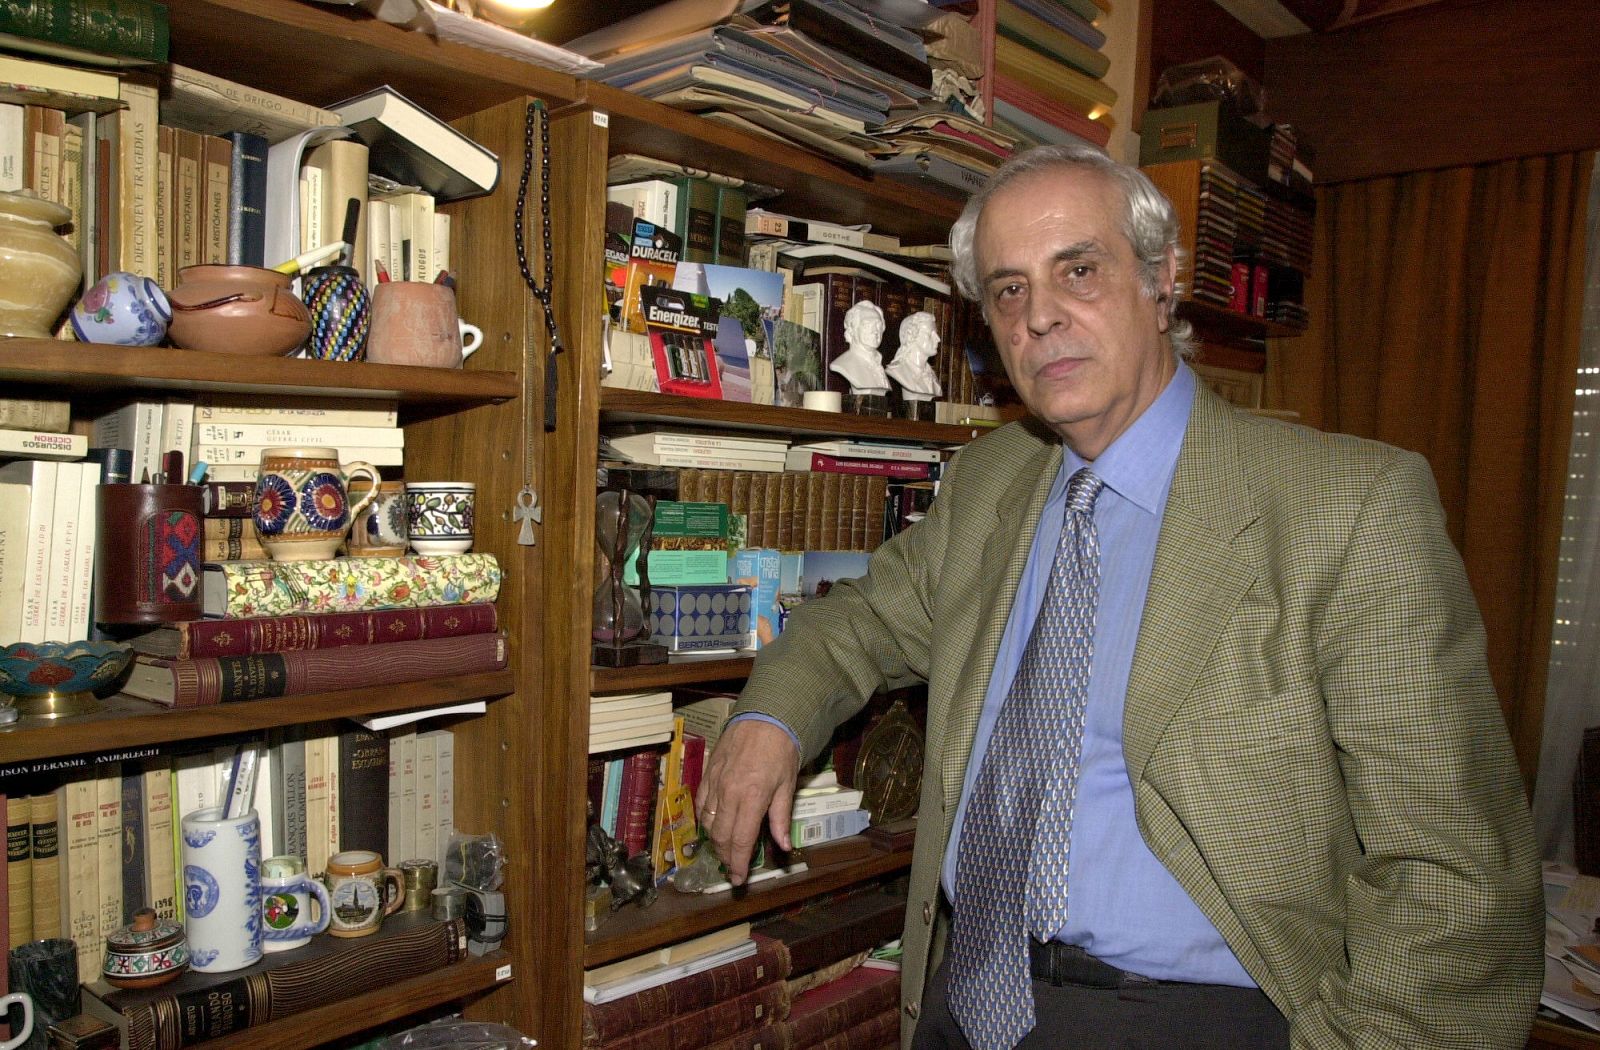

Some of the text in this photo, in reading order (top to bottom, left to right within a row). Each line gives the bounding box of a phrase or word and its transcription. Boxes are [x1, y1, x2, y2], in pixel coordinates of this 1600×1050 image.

[226, 87, 239, 98] DE
[243, 93, 282, 112] GRIEGO
[41, 167, 50, 199] OCLES
[133, 122, 145, 264] DIECINUEVE TRAGEDIAS
[822, 231, 851, 242] GOETHE
[184, 249, 192, 261] DE
[212, 254, 220, 265] DE
[418, 248, 426, 281] ALOGOS
[631, 246, 678, 263] DURACELL
[22, 440, 72, 451] DISCURSOS
[34, 435, 72, 444] CICERON
[34, 589, 41, 598] DE
[61, 590, 68, 599] DE
[33, 601, 41, 626] GUERRA
[59, 602, 67, 626] GUERRA
[232, 660, 243, 697] DANTE
[0, 748, 160, 777] ISON D'ERASME ANDERLECHT
[287, 773, 296, 809] VILLON
[298, 771, 306, 823] COMPLETA
